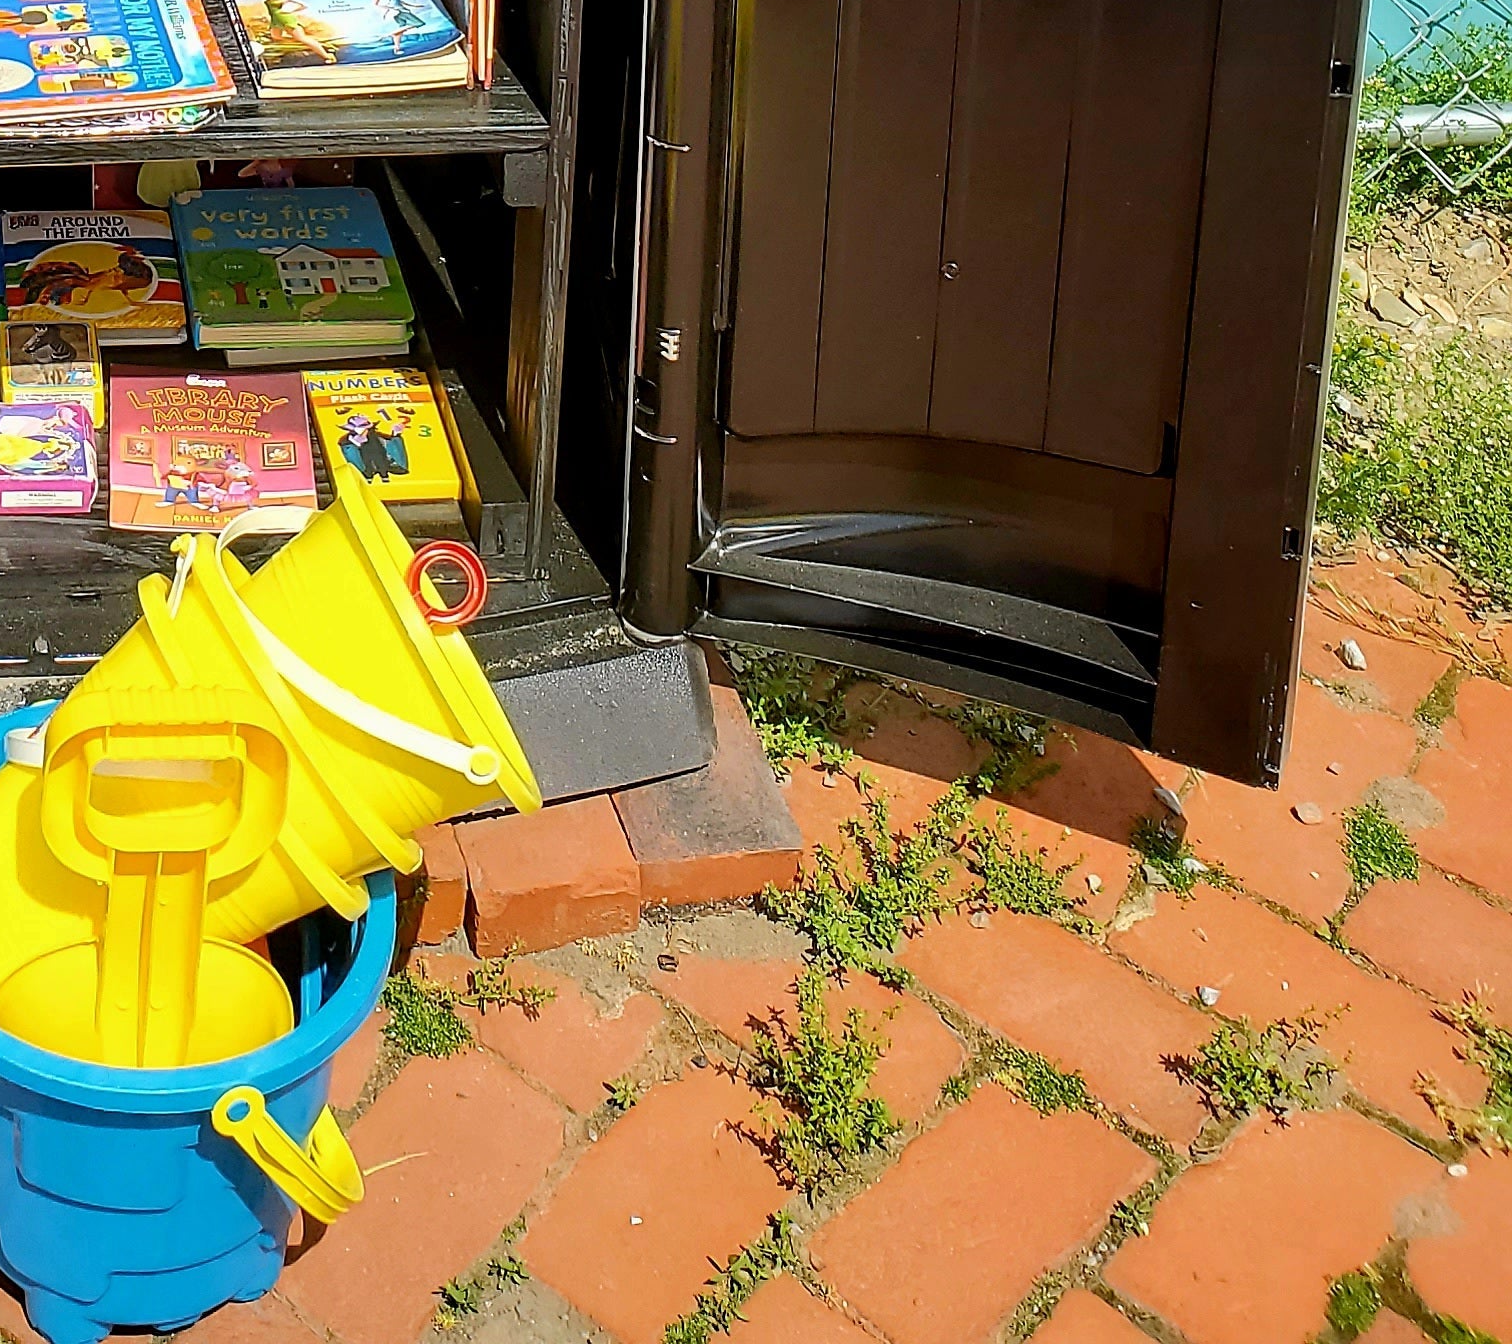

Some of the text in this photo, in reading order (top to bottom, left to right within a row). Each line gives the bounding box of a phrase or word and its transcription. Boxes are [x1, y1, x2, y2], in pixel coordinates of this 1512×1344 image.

[50, 215, 124, 228] AROUND
[200, 205, 351, 226] very first
[42, 227, 130, 239] THE FARM
[234, 224, 328, 240] words
[308, 376, 422, 391] NUMBERS
[126, 387, 288, 415] LIBRARY
[153, 407, 261, 429] MOUSE
